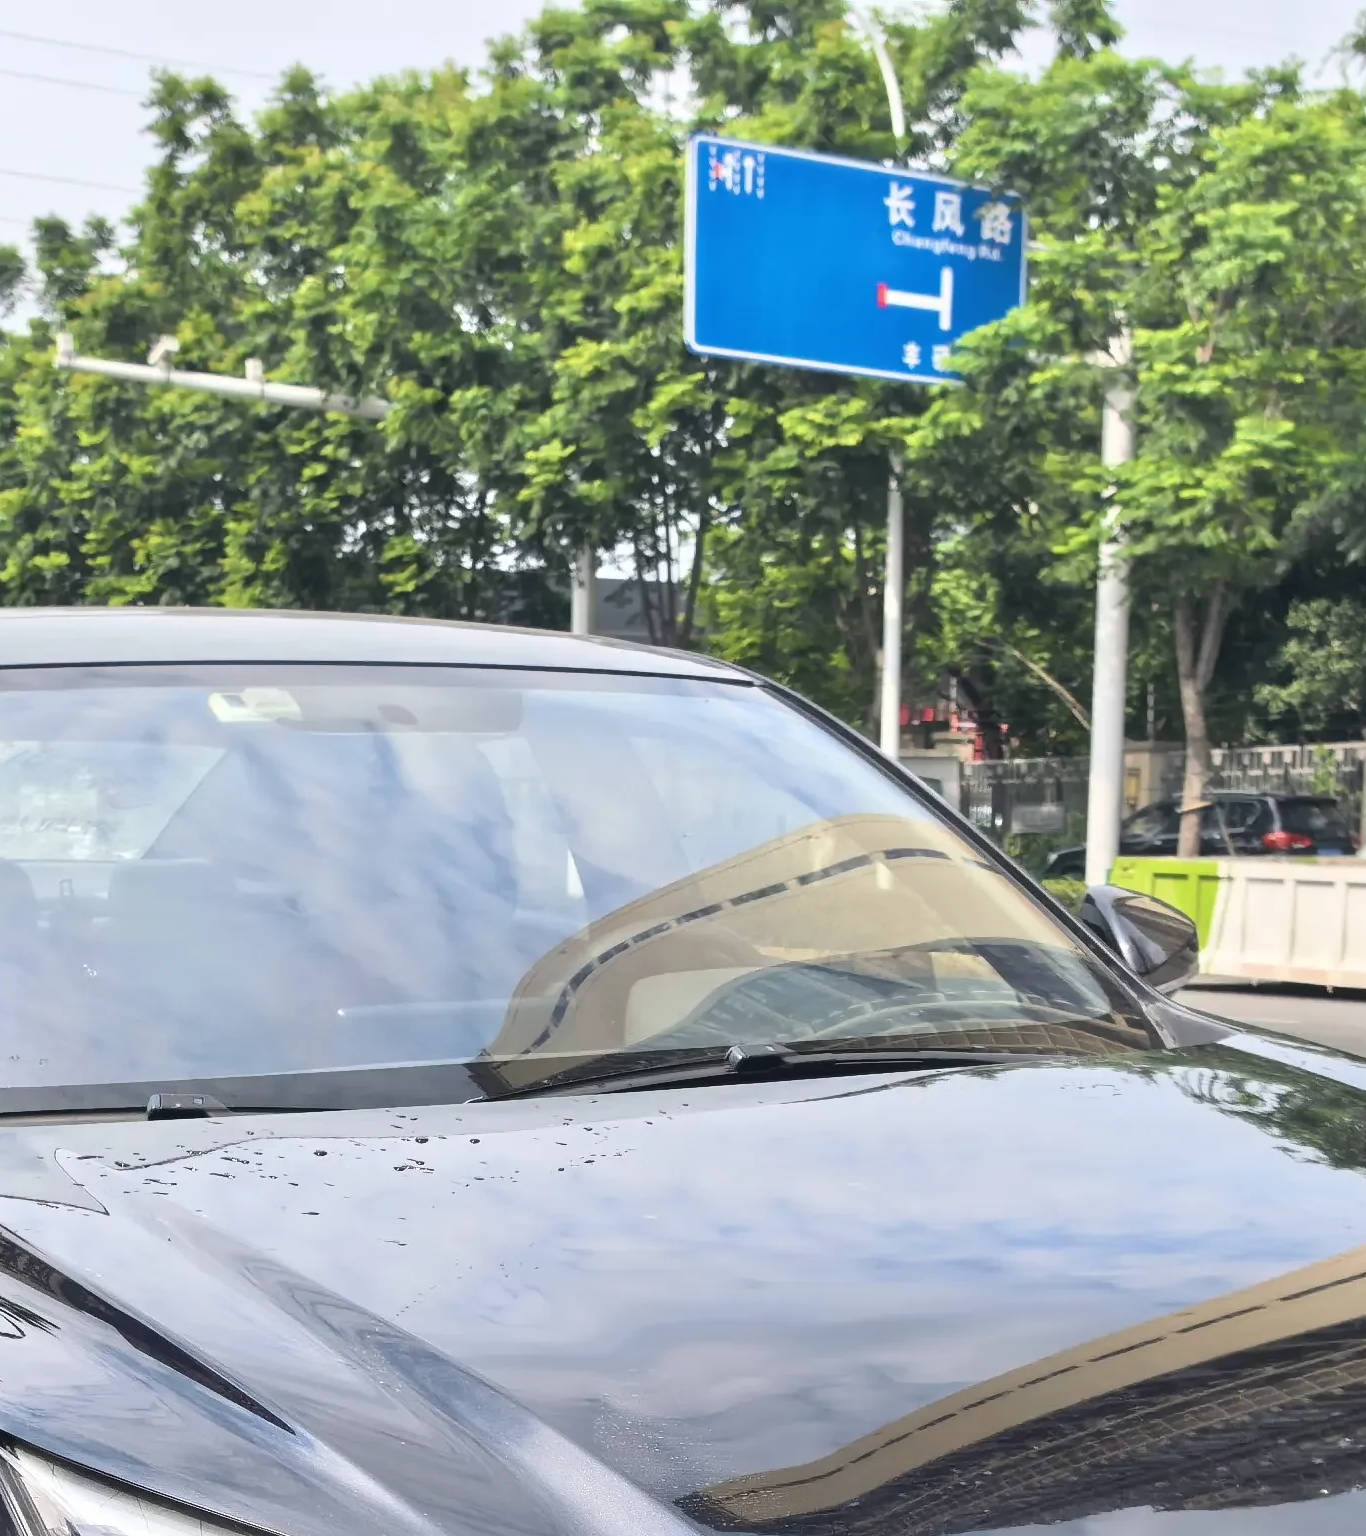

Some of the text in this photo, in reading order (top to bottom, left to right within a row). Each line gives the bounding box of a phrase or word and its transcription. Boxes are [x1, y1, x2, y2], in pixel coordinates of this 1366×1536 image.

[883, 182, 1012, 245] 长风路
[892, 230, 975, 261] Changfeng
